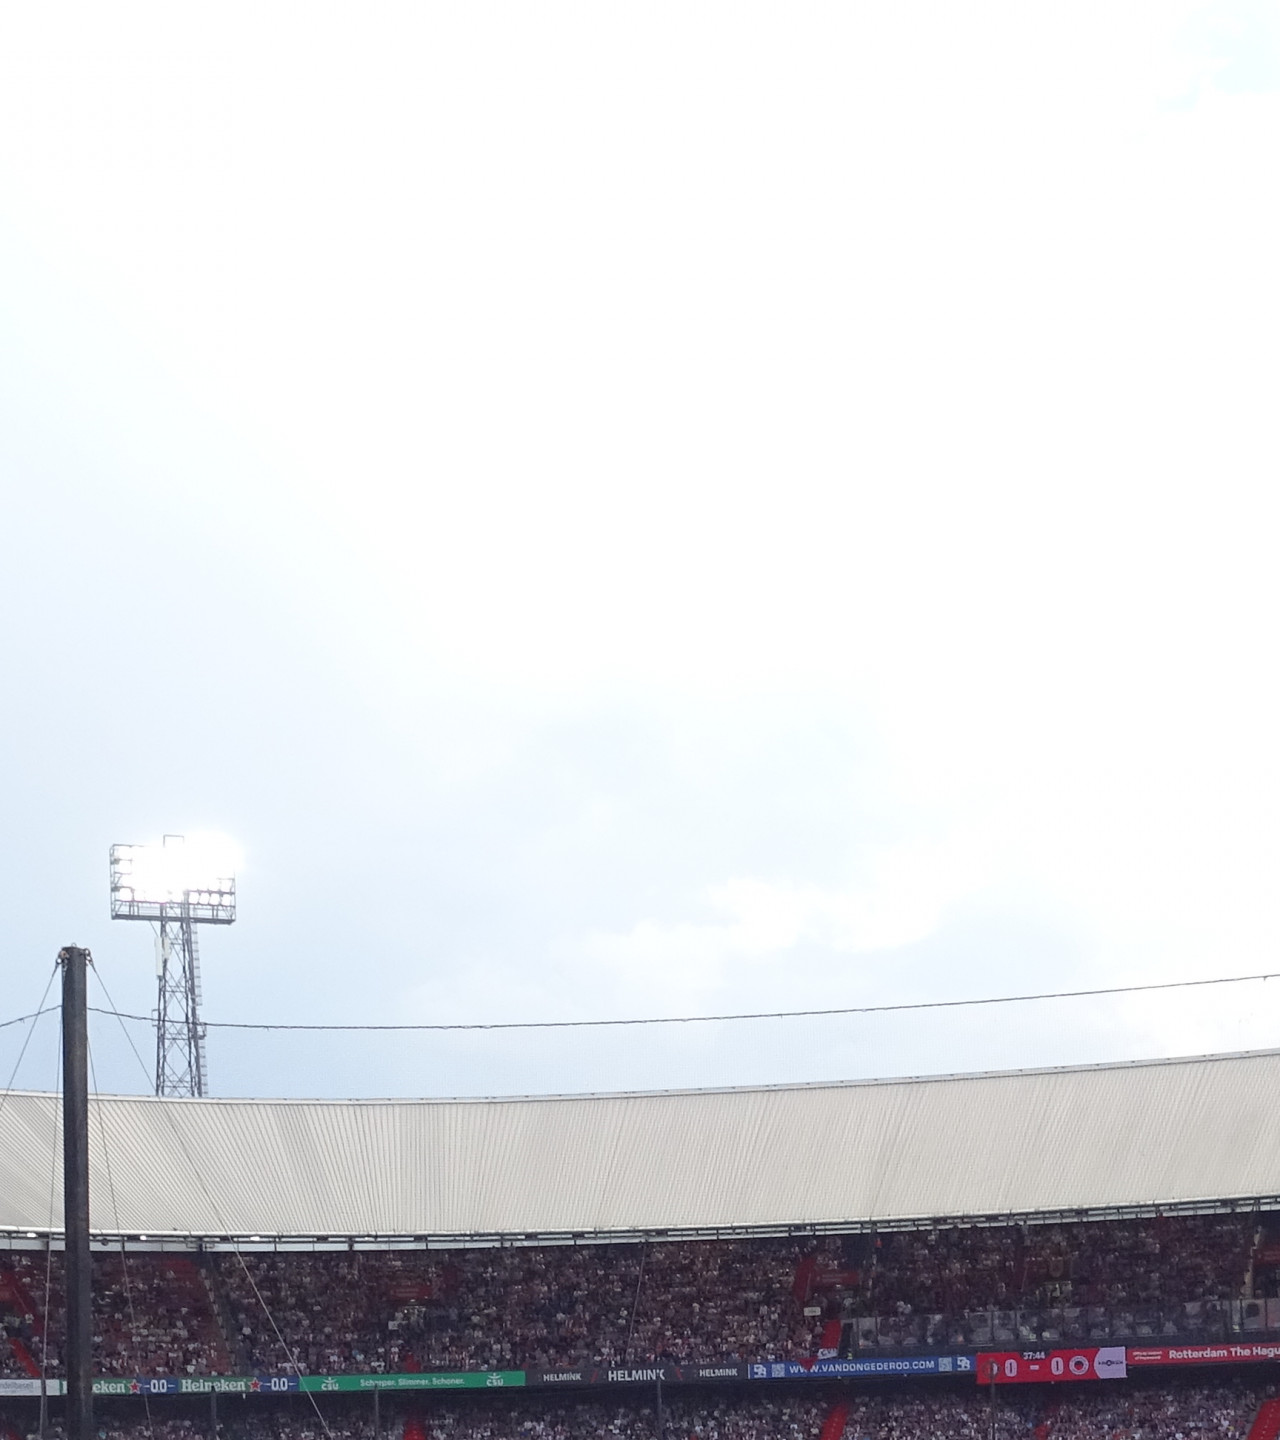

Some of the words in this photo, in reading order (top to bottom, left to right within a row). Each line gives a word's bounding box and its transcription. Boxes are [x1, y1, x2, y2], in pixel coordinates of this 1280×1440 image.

[1023, 1352, 1046, 1361] 37:44
[1169, 1348, 1226, 1360] Rotterdam
[1229, 1347, 1250, 1357] The
[608, 1369, 665, 1381] HELMINK
[699, 1368, 738, 1377] HELMINK
[398, 1378, 429, 1386] Slimmer.
[432, 1377, 465, 1385] Schoner.
[543, 1373, 582, 1382] HELMINK
[181, 1378, 246, 1392] Heineken
